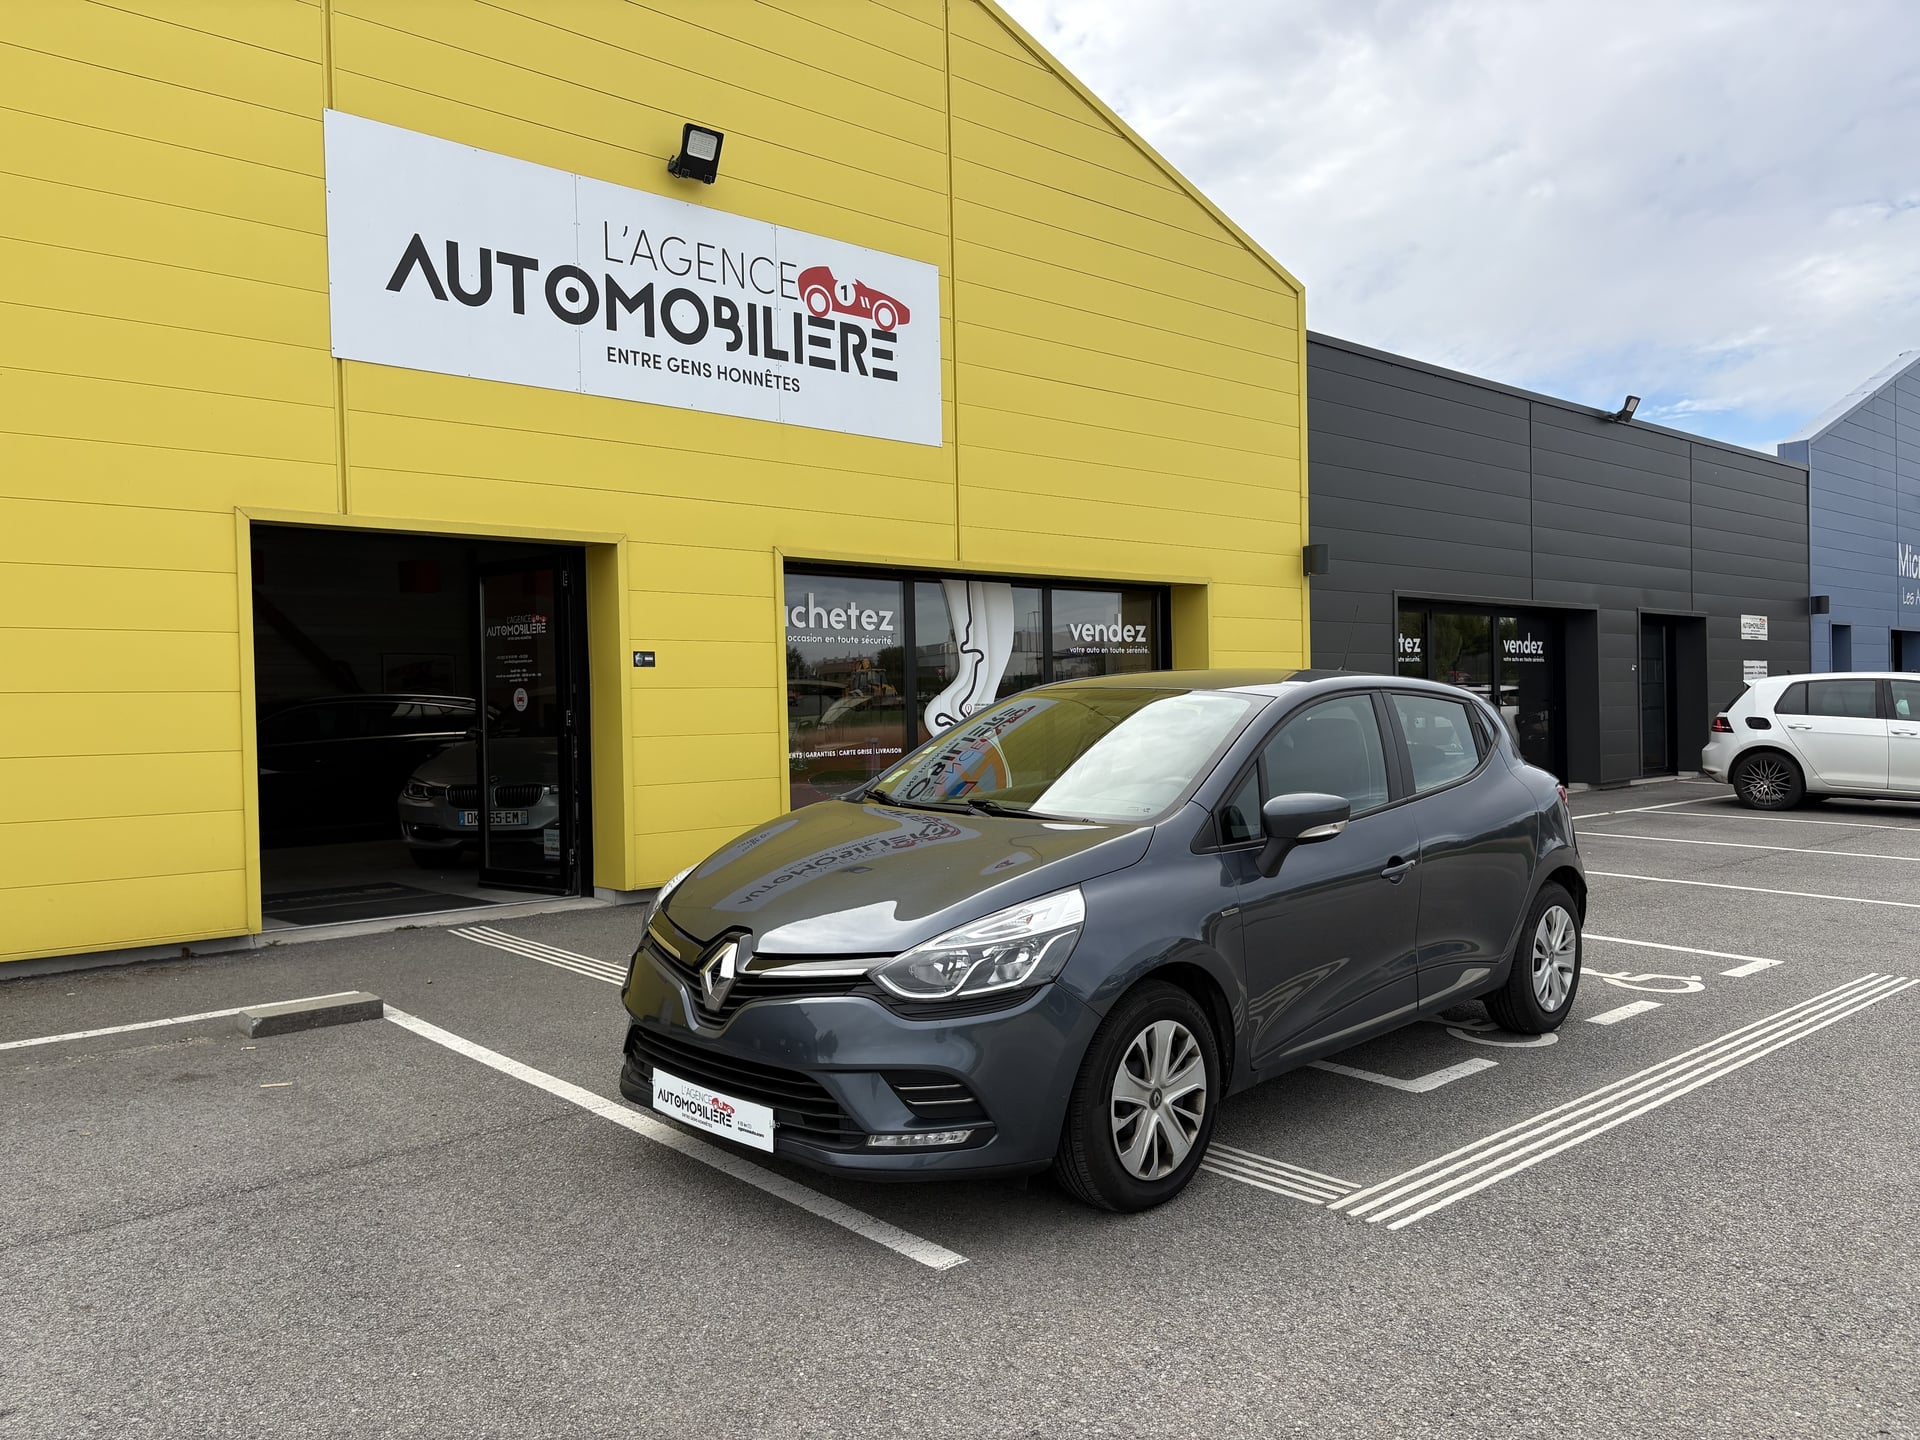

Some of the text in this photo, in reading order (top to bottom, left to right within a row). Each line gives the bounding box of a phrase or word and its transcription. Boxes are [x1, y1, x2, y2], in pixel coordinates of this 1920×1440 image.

[604, 221, 798, 300] L'AGENCE
[840, 285, 848, 302] 1
[386, 233, 898, 382] AUTOMOBILIERE
[607, 346, 800, 392] ENTRE GENS HONNÊTES
[1903, 586, 1914, 605] Les
[784, 592, 894, 631] chetez
[787, 633, 823, 643] occasion
[838, 635, 859, 644] toute
[1069, 613, 1146, 642] vendez
[1503, 632, 1543, 654] vendez
[805, 750, 836, 758] GARANTIES
[875, 747, 902, 755] LIVRAISON
